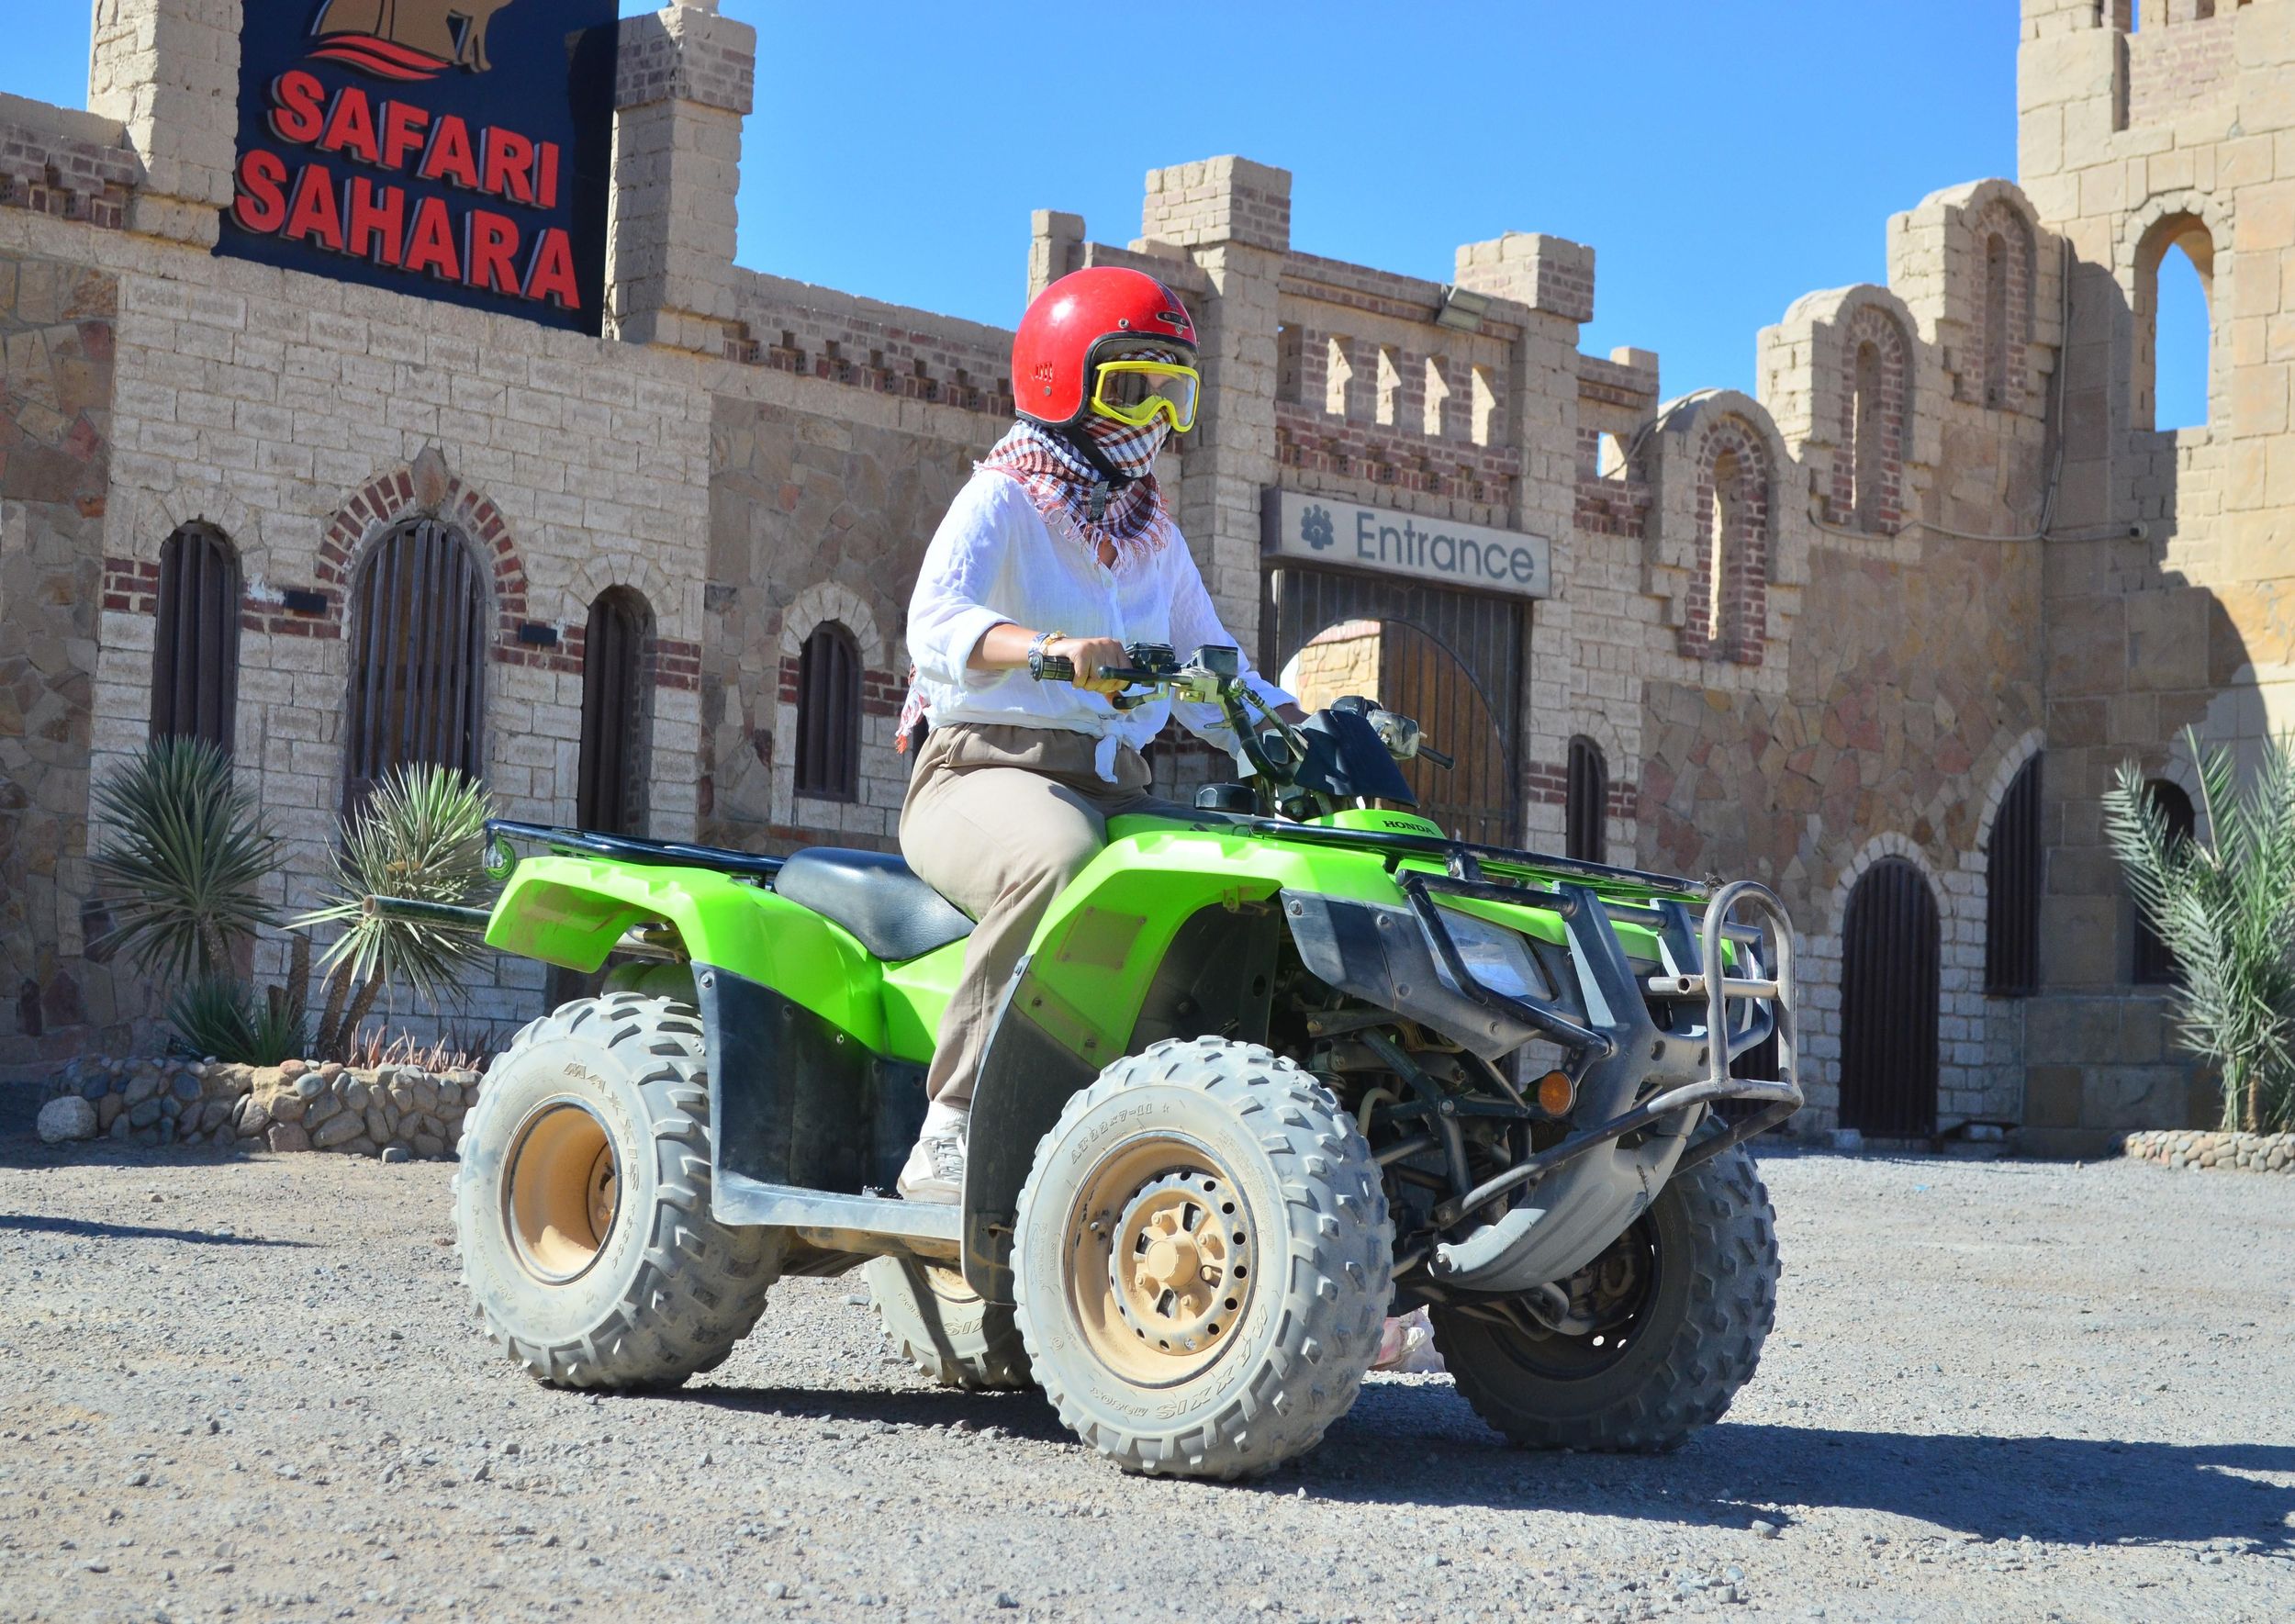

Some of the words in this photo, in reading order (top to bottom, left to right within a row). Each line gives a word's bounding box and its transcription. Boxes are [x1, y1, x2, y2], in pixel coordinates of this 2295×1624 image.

[272, 70, 559, 209] SAFARI
[230, 149, 581, 310] SAHARA
[1356, 510, 1535, 584] Entrance
[1383, 820, 1437, 835] HONDA
